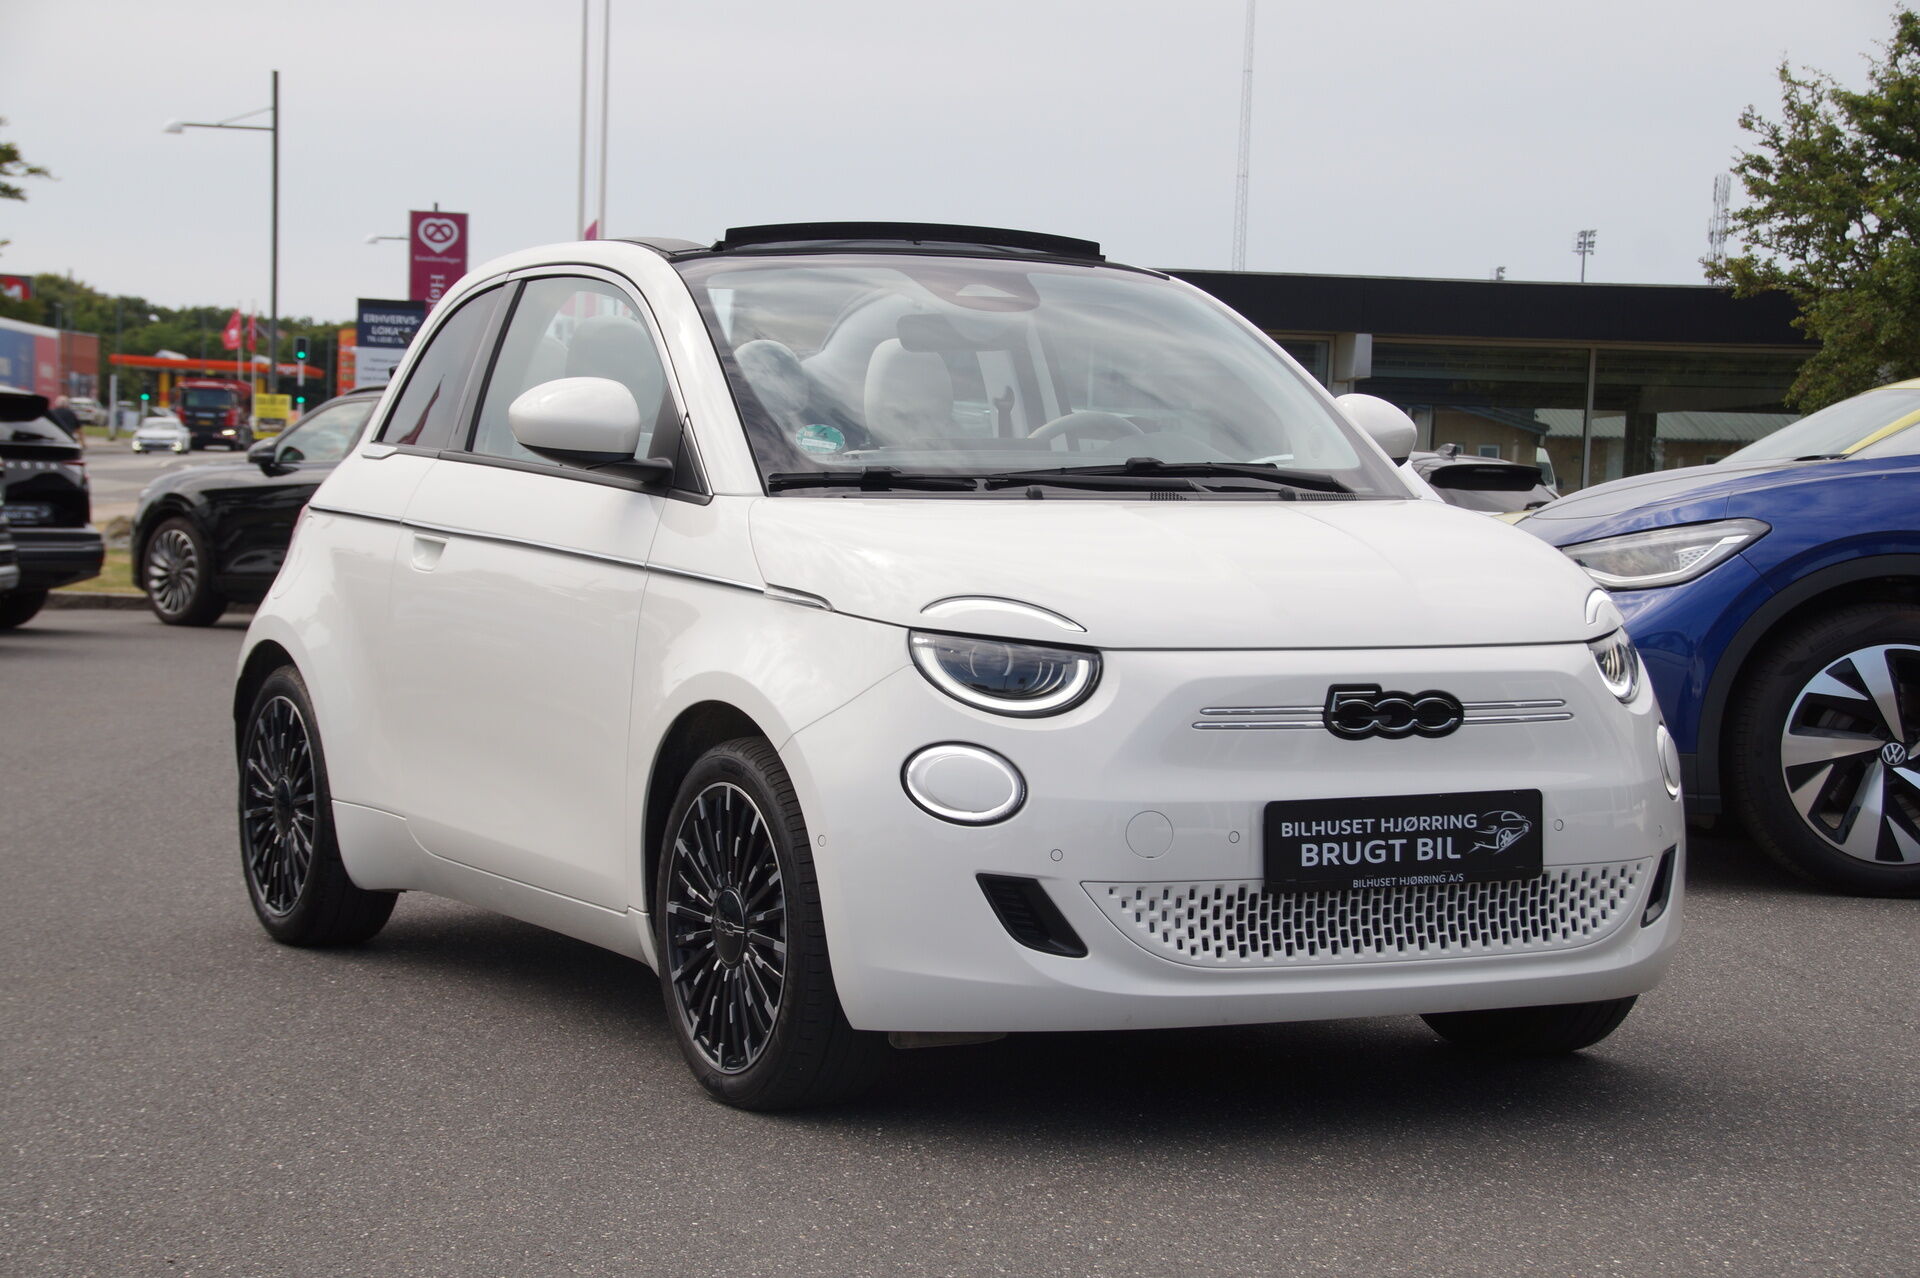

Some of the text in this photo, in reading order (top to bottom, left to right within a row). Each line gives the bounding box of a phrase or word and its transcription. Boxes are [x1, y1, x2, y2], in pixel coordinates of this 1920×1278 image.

[363, 313, 419, 326] ERHVERVS-
[1323, 683, 1464, 741] 500
[1281, 813, 1478, 838] BILHUSET HJØRRING
[1300, 837, 1462, 868] BRUGT BIL
[1352, 872, 1464, 889] BILHUSET HJØRRING A/S
